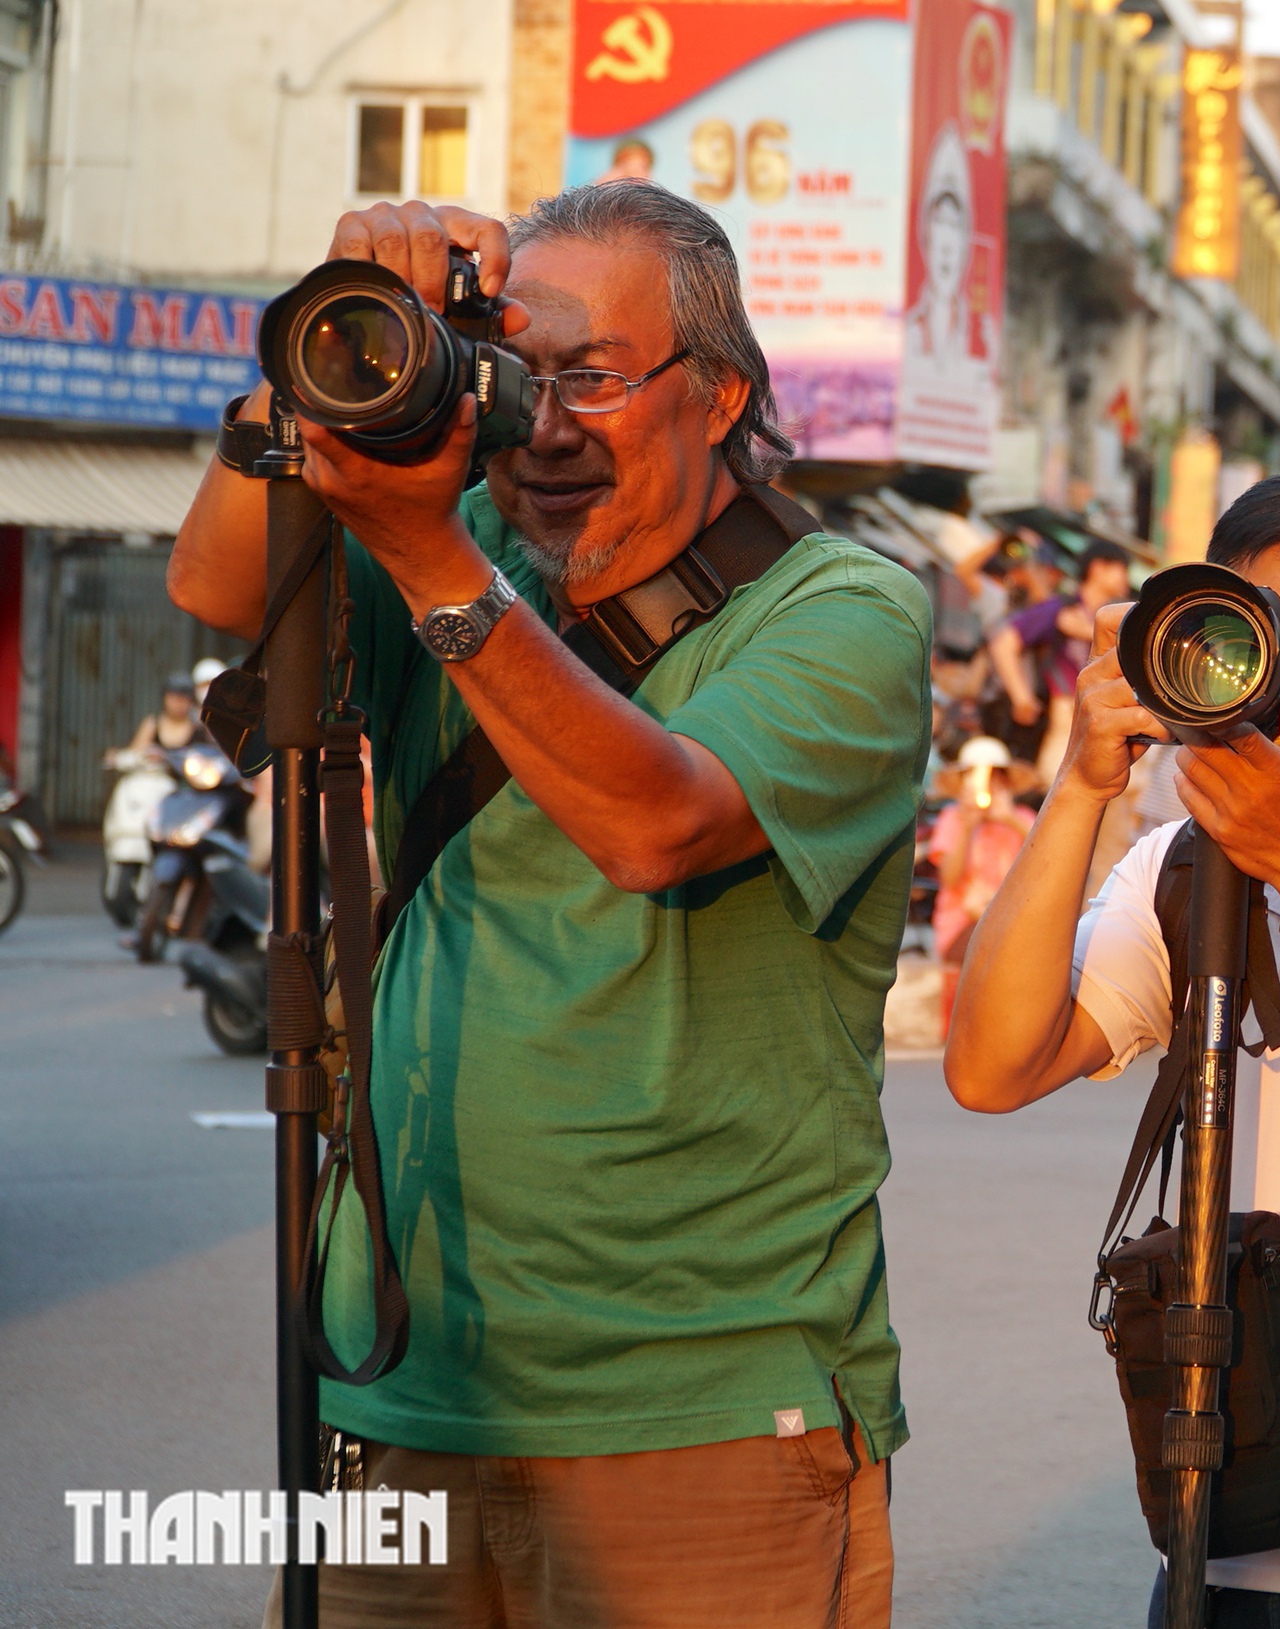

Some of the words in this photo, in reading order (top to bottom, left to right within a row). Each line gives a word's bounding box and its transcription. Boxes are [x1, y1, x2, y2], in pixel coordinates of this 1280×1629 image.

[690, 117, 791, 206] 96
[477, 360, 492, 402] Nikon
[1213, 997, 1226, 1043] Leofoto
[1217, 1069, 1227, 1112] MP-364C
